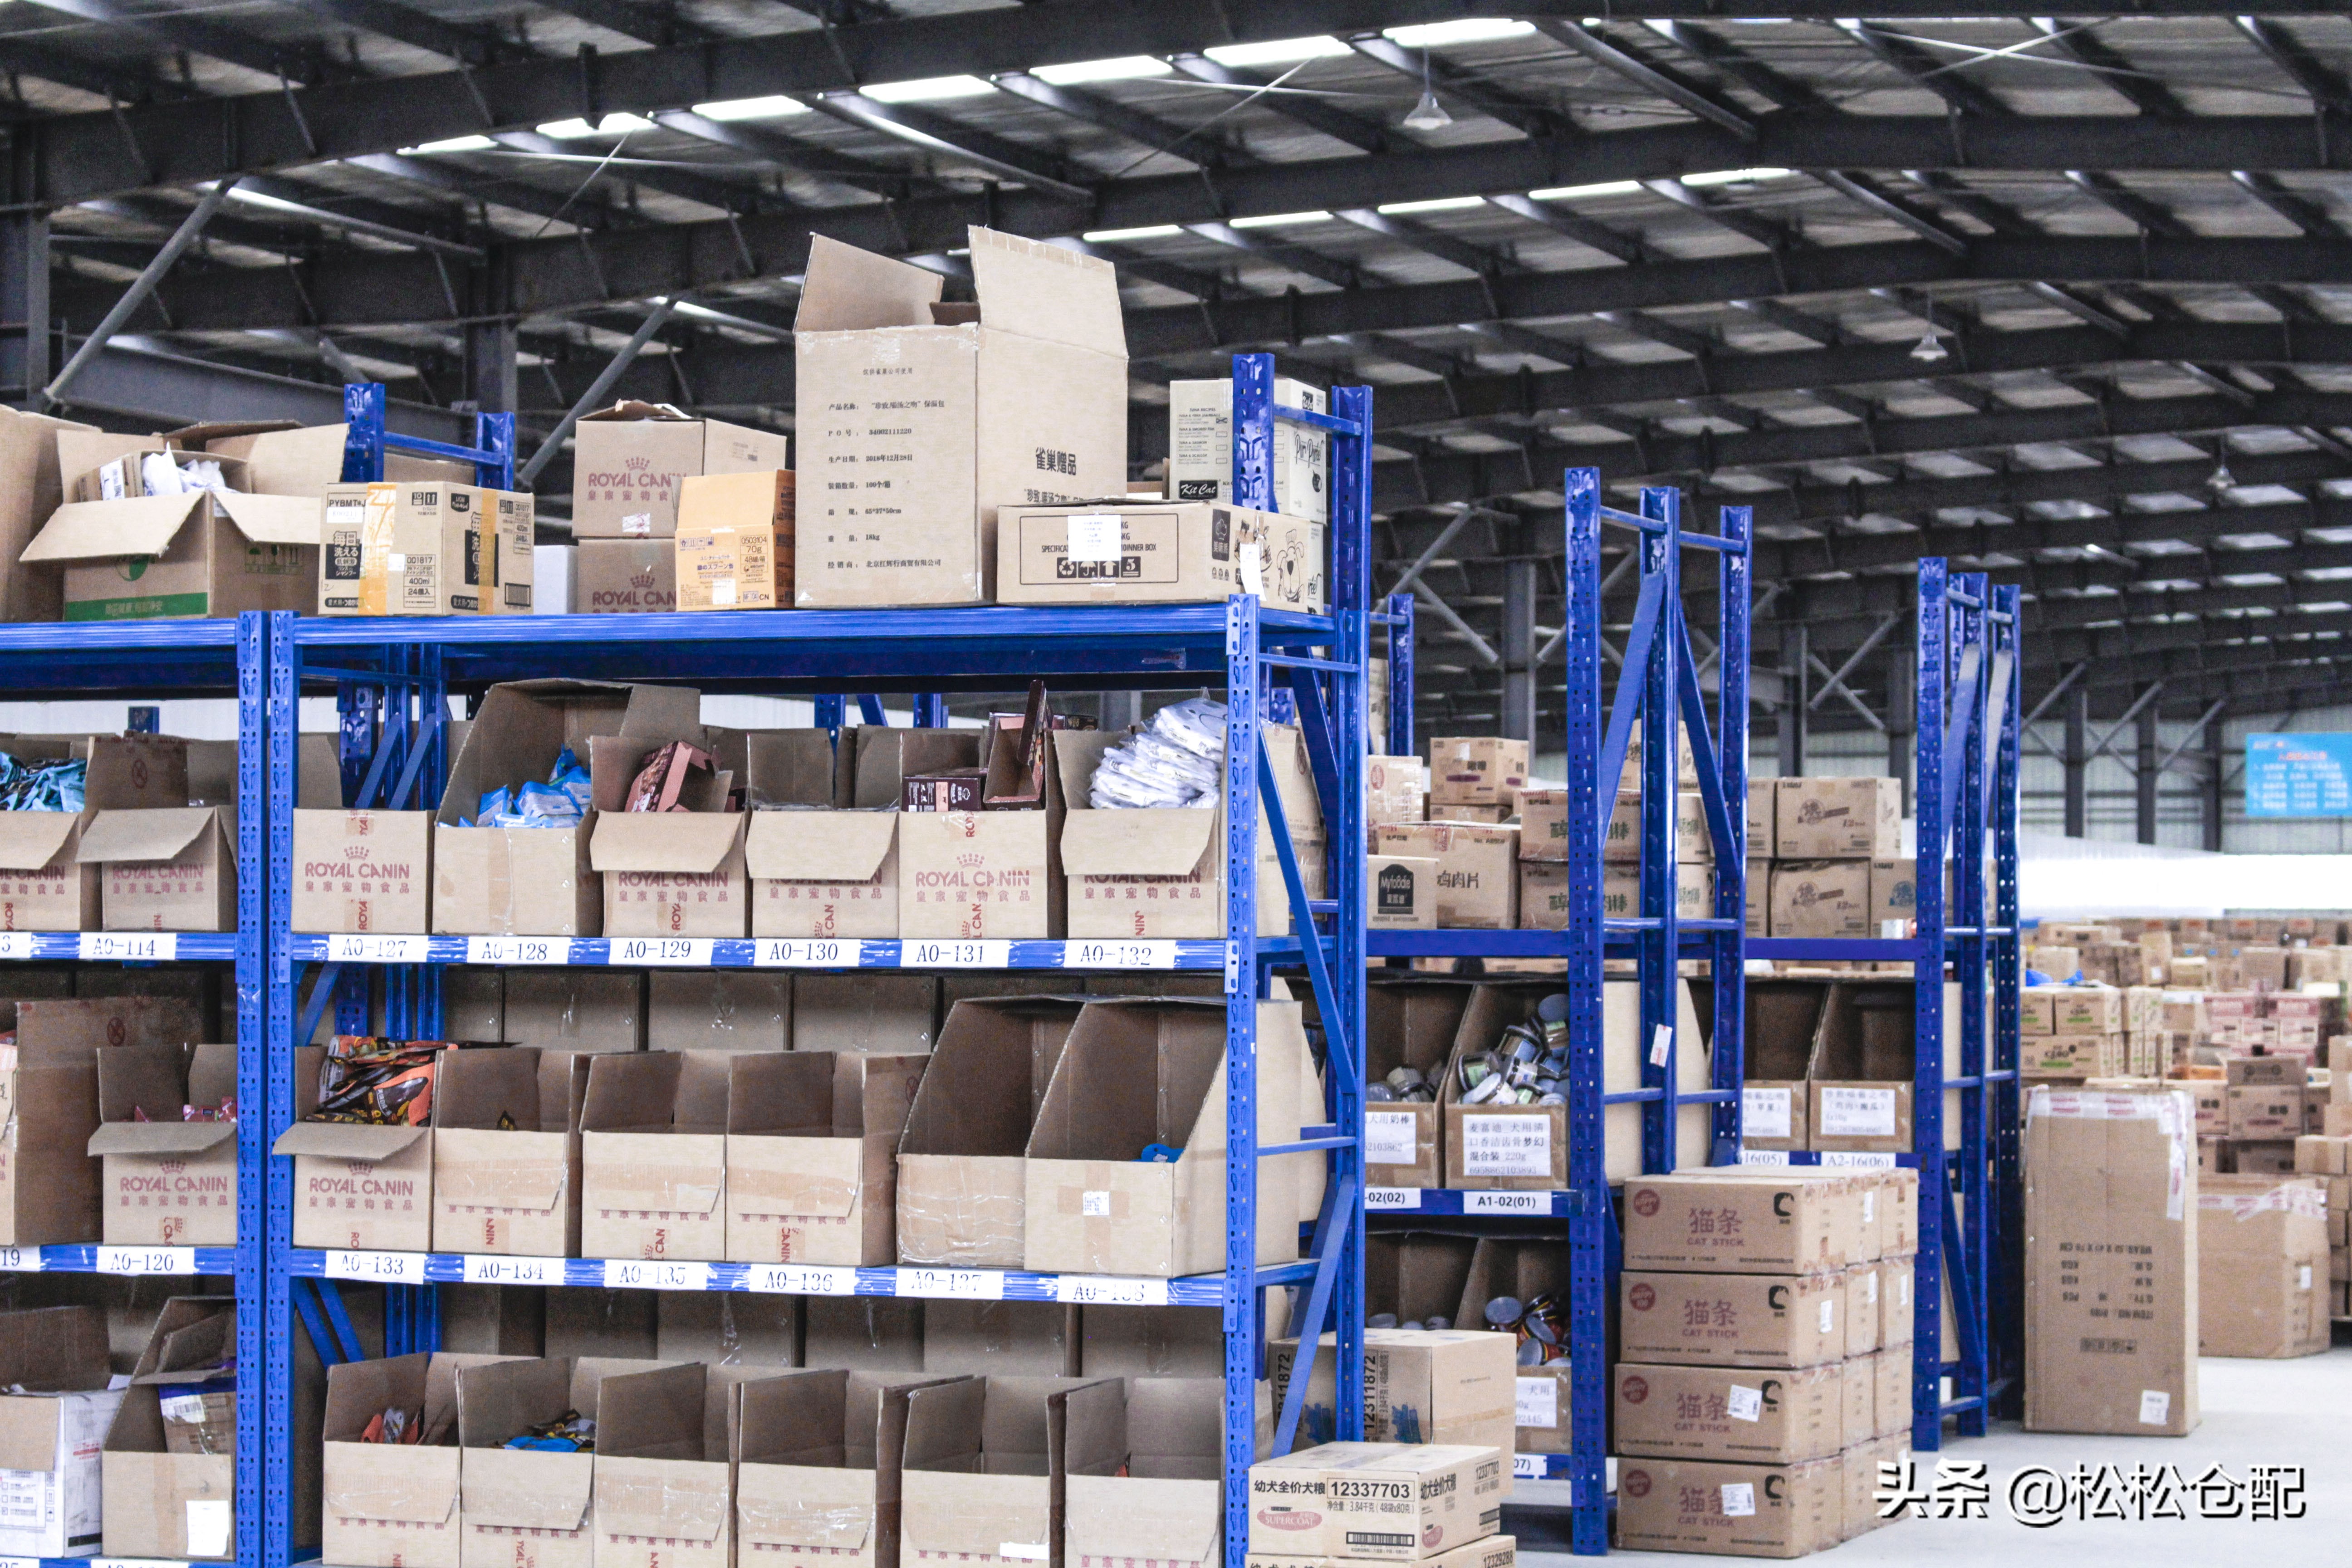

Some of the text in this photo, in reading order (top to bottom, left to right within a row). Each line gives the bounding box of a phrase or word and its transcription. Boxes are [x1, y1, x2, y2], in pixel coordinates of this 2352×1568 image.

[1036, 447, 1077, 475] 雀巢赠品
[588, 473, 634, 487] ROYAL
[588, 490, 668, 501] 皇家宠物食
[1181, 483, 1216, 495] Kit Cat
[741, 536, 767, 544] 0503104
[334, 547, 358, 557] 洗える
[747, 545, 762, 554] 70g
[1126, 559, 1136, 571] 5
[593, 591, 640, 605] ROYAL
[644, 591, 676, 605] CAN
[113, 865, 204, 879] ROYAL CANIN
[305, 862, 410, 879] ROYAL CANIN
[618, 871, 728, 887] ROYAL CANIN
[916, 869, 1030, 887] ROYAL CANIN
[305, 881, 410, 894] 皇家宠物食品
[769, 887, 882, 899] 皇家宠物食品
[1085, 887, 1201, 899] 皇家宠物食品
[619, 890, 728, 902] 皇家宠物食品
[916, 890, 1030, 902] 皇家宠物食品
[624, 941, 691, 959] A0-129
[769, 942, 838, 960] A0-130
[916, 944, 984, 963] A0-131
[1745, 1152, 1782, 1166] 16(05)
[120, 1176, 227, 1192] ROYAL CANIN
[309, 1177, 413, 1196] ROYAL CANIN
[1364, 1192, 1405, 1205] -02(02)
[1478, 1196, 1536, 1209] A1-02(01)
[1689, 1207, 1743, 1235] 猫条
[1686, 1237, 1745, 1246] CAT STICK
[1685, 1299, 1738, 1326] 猫条
[1682, 1328, 1739, 1338] CAT STICK
[1676, 1393, 1729, 1420] 猫条
[1675, 1423, 1731, 1433] CAT STICK
[1254, 1480, 1326, 1495] 幼犬全价犬粮
[1331, 1481, 1411, 1499] 12337703
[1420, 1472, 1456, 1500] 幼犬全价犬粮
[1265, 1514, 1315, 1527] SUPERCOAT
[1678, 1516, 1734, 1528] CAT STICK
